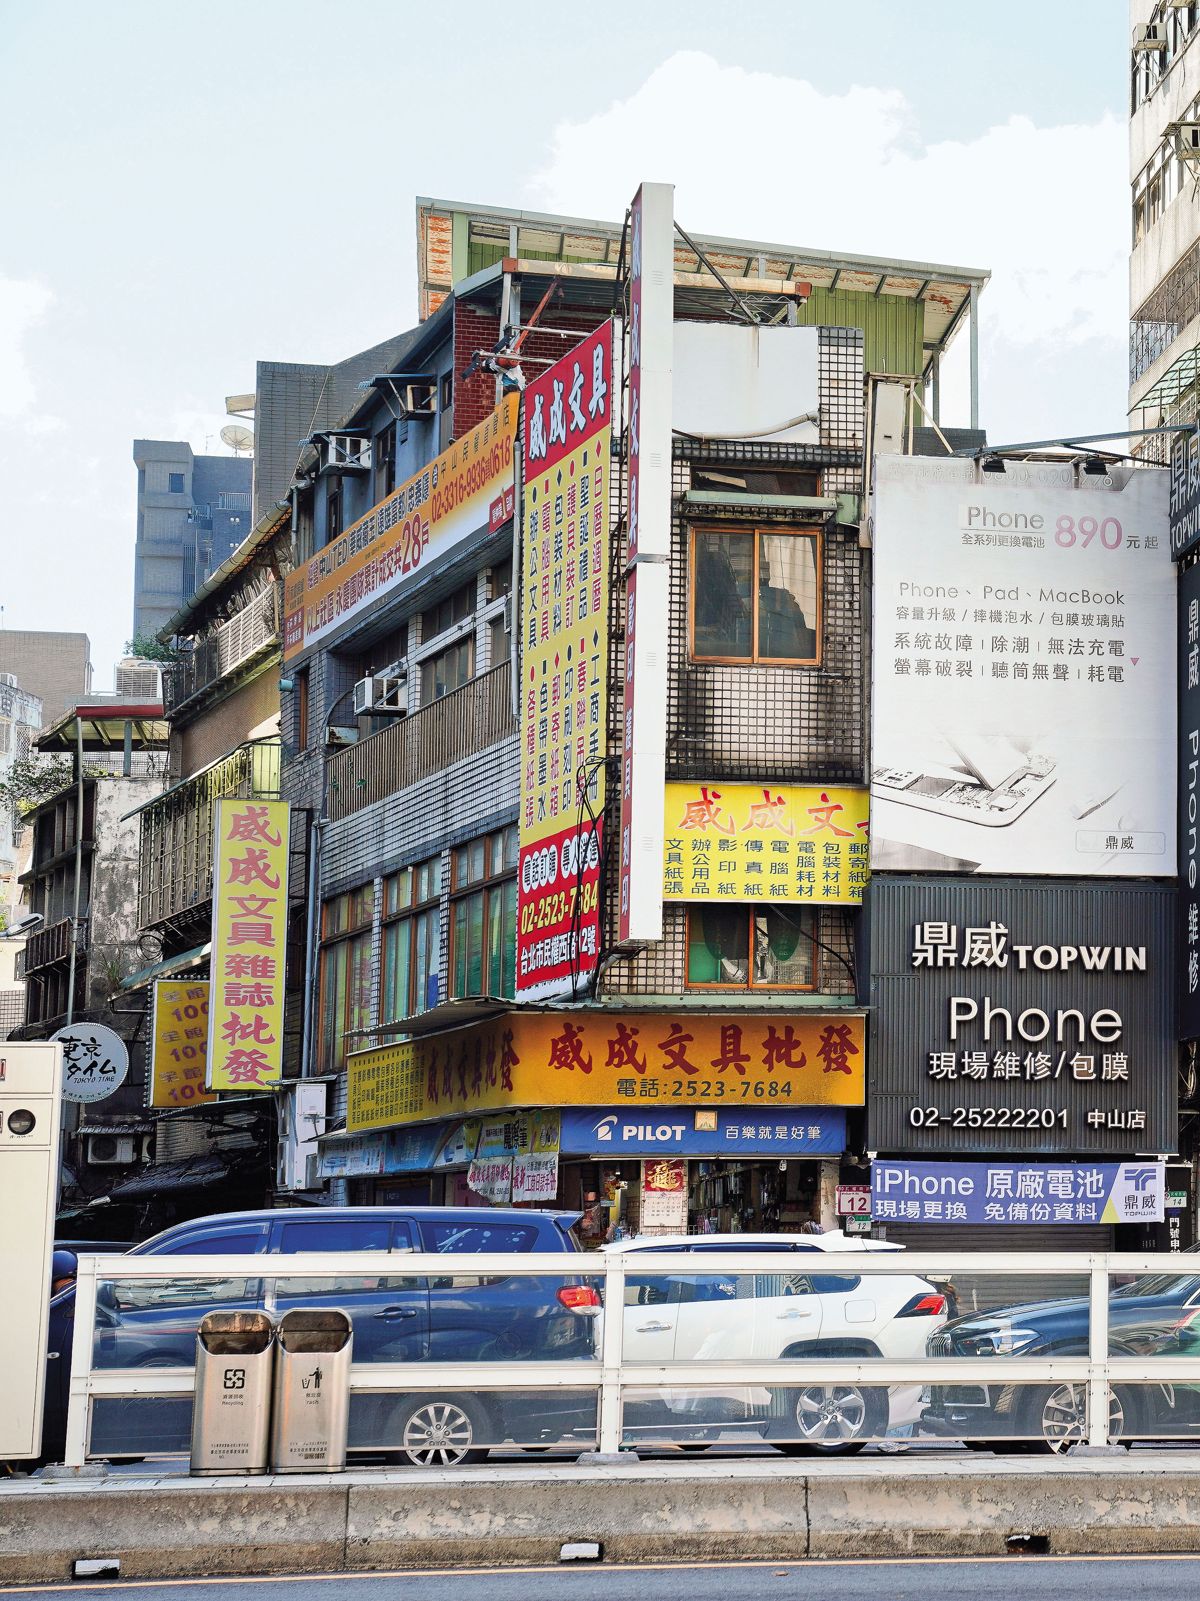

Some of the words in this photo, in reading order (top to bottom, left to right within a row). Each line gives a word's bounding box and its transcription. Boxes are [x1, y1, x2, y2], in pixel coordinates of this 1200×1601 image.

[528, 343, 607, 460] 威成文具
[967, 506, 1045, 530] Phone
[1055, 515, 1123, 549] 890
[578, 474, 589, 620] 聖誕禮品
[961, 534, 1045, 549] 全系列更換電池
[553, 494, 563, 636] 包裝材料
[678, 786, 870, 838] 威成文
[1105, 835, 1134, 850] 鼎威
[664, 838, 684, 894] 文具紙張
[691, 838, 711, 894] 辦公用品
[717, 839, 737, 895] 影印紙
[743, 839, 764, 896] 傳真紙
[769, 840, 789, 896] 電腦紙
[796, 841, 816, 897] 電腦耗材
[822, 842, 841, 898] 包裝材料
[220, 805, 282, 1087] 威成文具雜誌批發
[912, 920, 1009, 969] 鼎威
[1013, 945, 1147, 972] TOPWIN
[1188, 903, 1200, 994] 維修
[950, 996, 1123, 1043] Phone
[58, 1036, 102, 1063] 東京
[547, 1021, 860, 1076] 威成文具批發
[67, 1059, 116, 1080] タイム
[622, 1125, 686, 1141] PILOT
[726, 1125, 821, 1140] 百樂就是好筆
[909, 1106, 1069, 1129] 02-25222201
[1087, 1109, 1146, 1129] 中山店
[848, 1197, 867, 1211] 12
[875, 1168, 975, 1196] iPhone
[985, 1168, 1105, 1200] 原廠電池
[1124, 1194, 1156, 1210] 鼎威
[1173, 1198, 1182, 1206] 14
[857, 1222, 867, 1230] 12
[875, 1201, 968, 1220] 現場更換
[984, 1201, 1098, 1221] 免備份資料
[1169, 1217, 1181, 1253] 門號申
